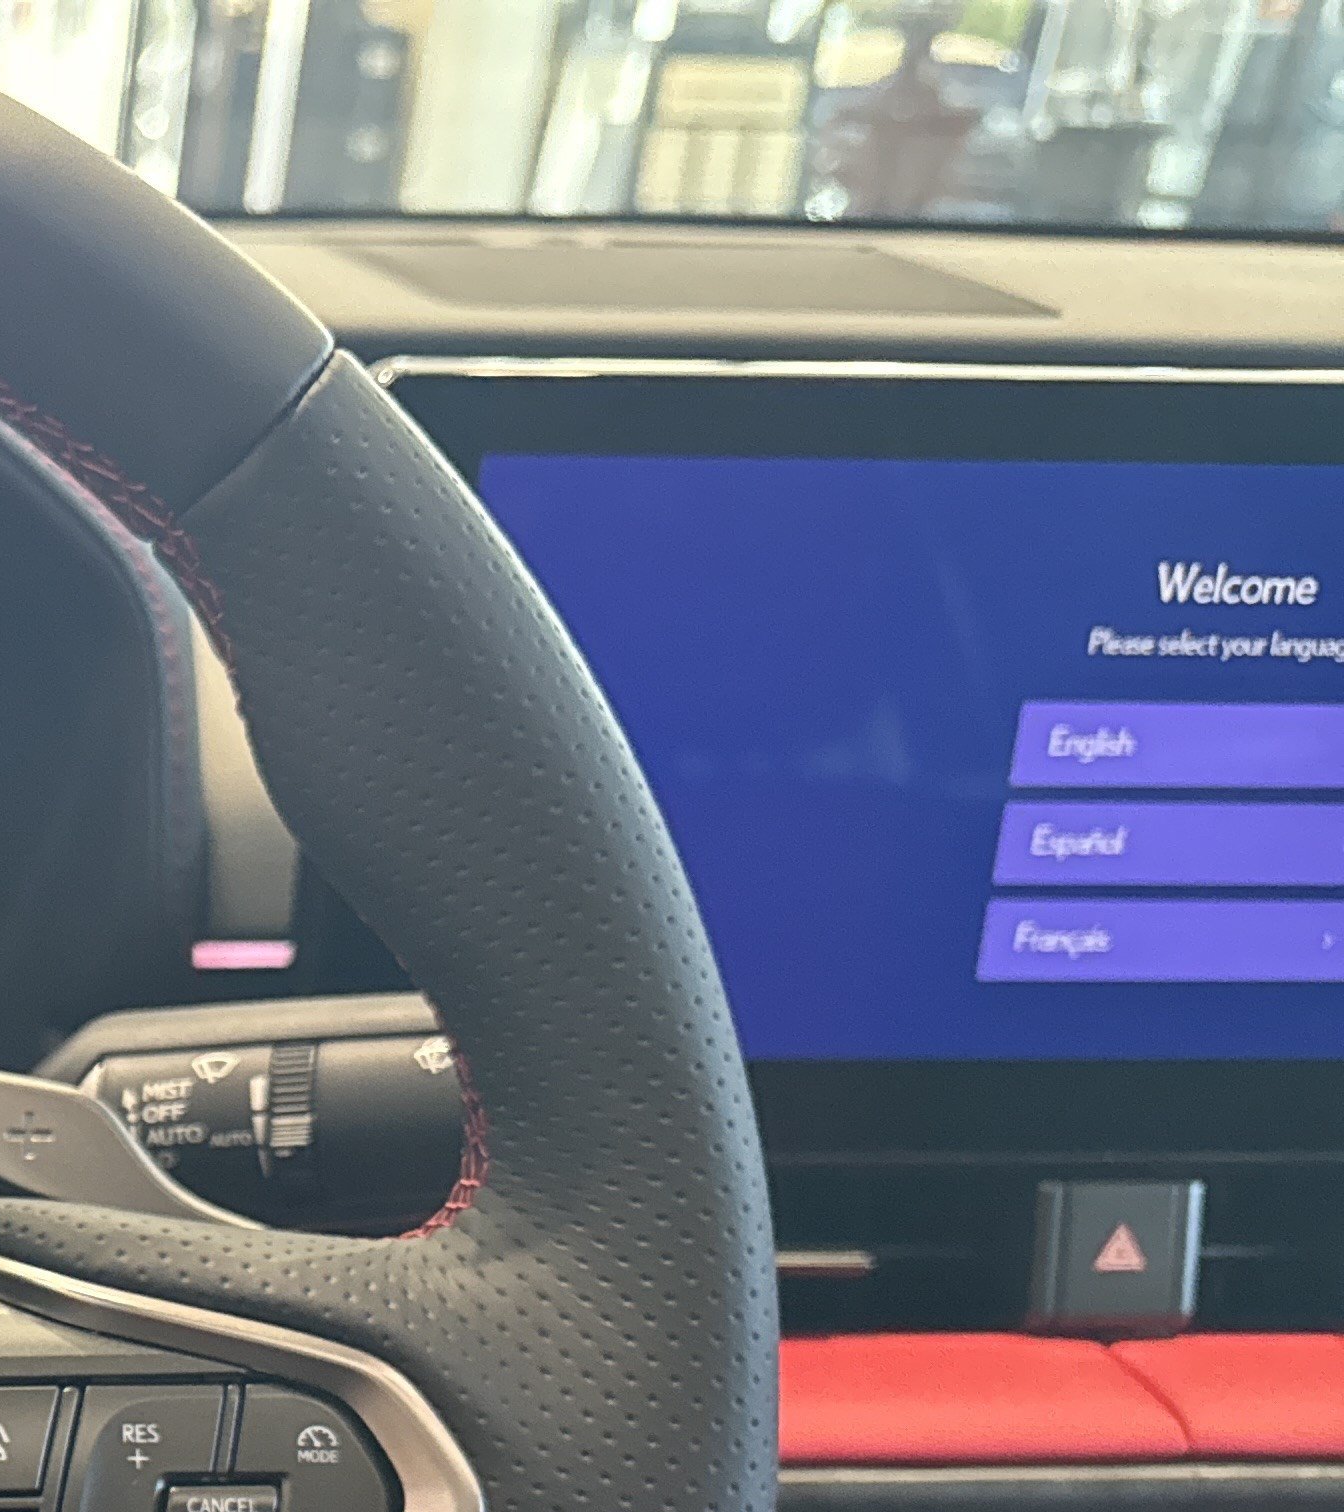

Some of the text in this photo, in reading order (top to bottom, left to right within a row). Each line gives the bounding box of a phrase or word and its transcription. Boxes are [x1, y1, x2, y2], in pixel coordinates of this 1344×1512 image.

[1158, 560, 1318, 605] Welcome
[1088, 626, 1154, 655] Please
[1158, 628, 1218, 655] select
[1220, 636, 1266, 662] your
[1048, 724, 1135, 763] English
[1030, 823, 1129, 861] Español
[1014, 919, 1111, 959] Français
[142, 1078, 193, 1102] MIST
[142, 1102, 188, 1124] OFF
[148, 1122, 208, 1147] AUTO
[122, 1423, 160, 1443] RES
[297, 1450, 339, 1463] MODE
